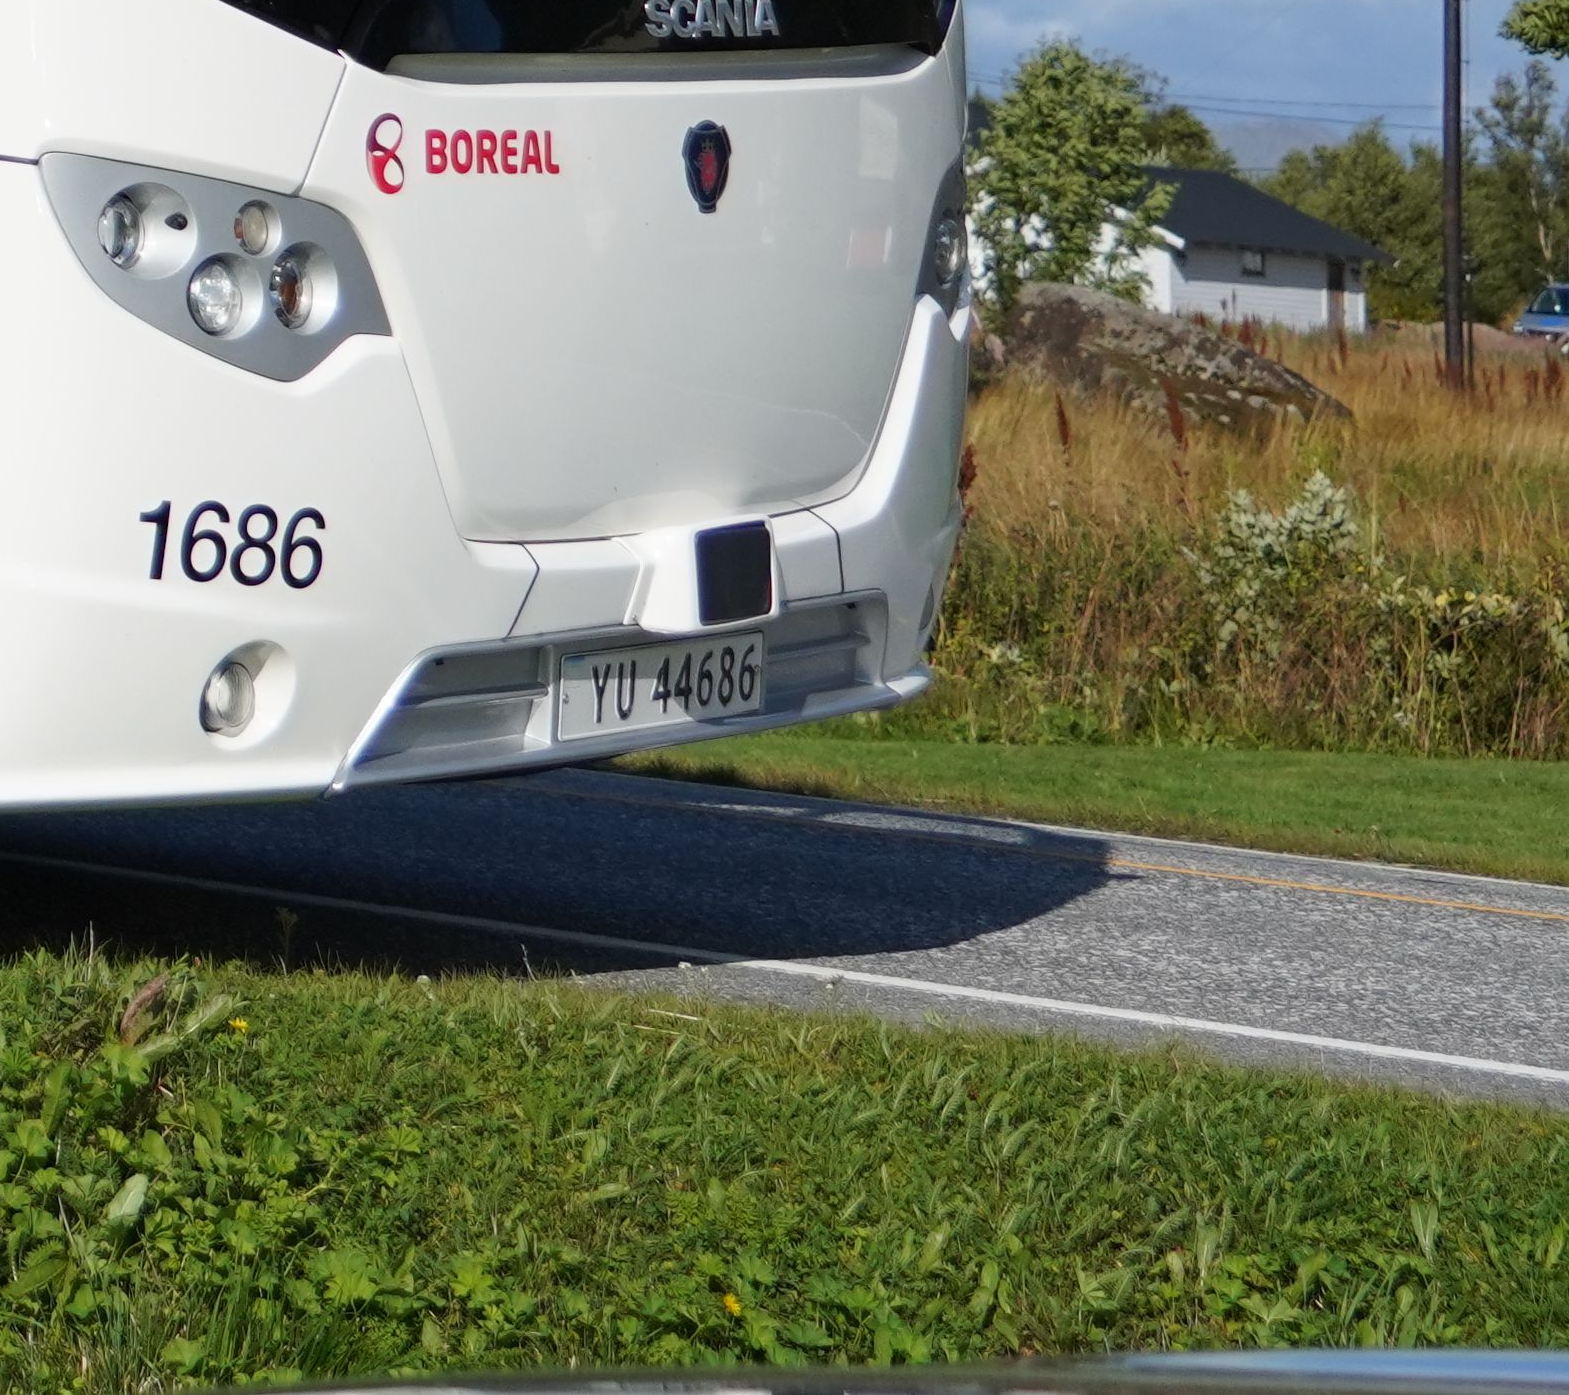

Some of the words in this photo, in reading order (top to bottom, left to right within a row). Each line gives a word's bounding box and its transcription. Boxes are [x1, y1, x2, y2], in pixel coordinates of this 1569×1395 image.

[425, 129, 560, 175] BOREAL
[139, 500, 326, 589] 1686
[592, 660, 637, 724] YU
[650, 644, 755, 714] 44686
